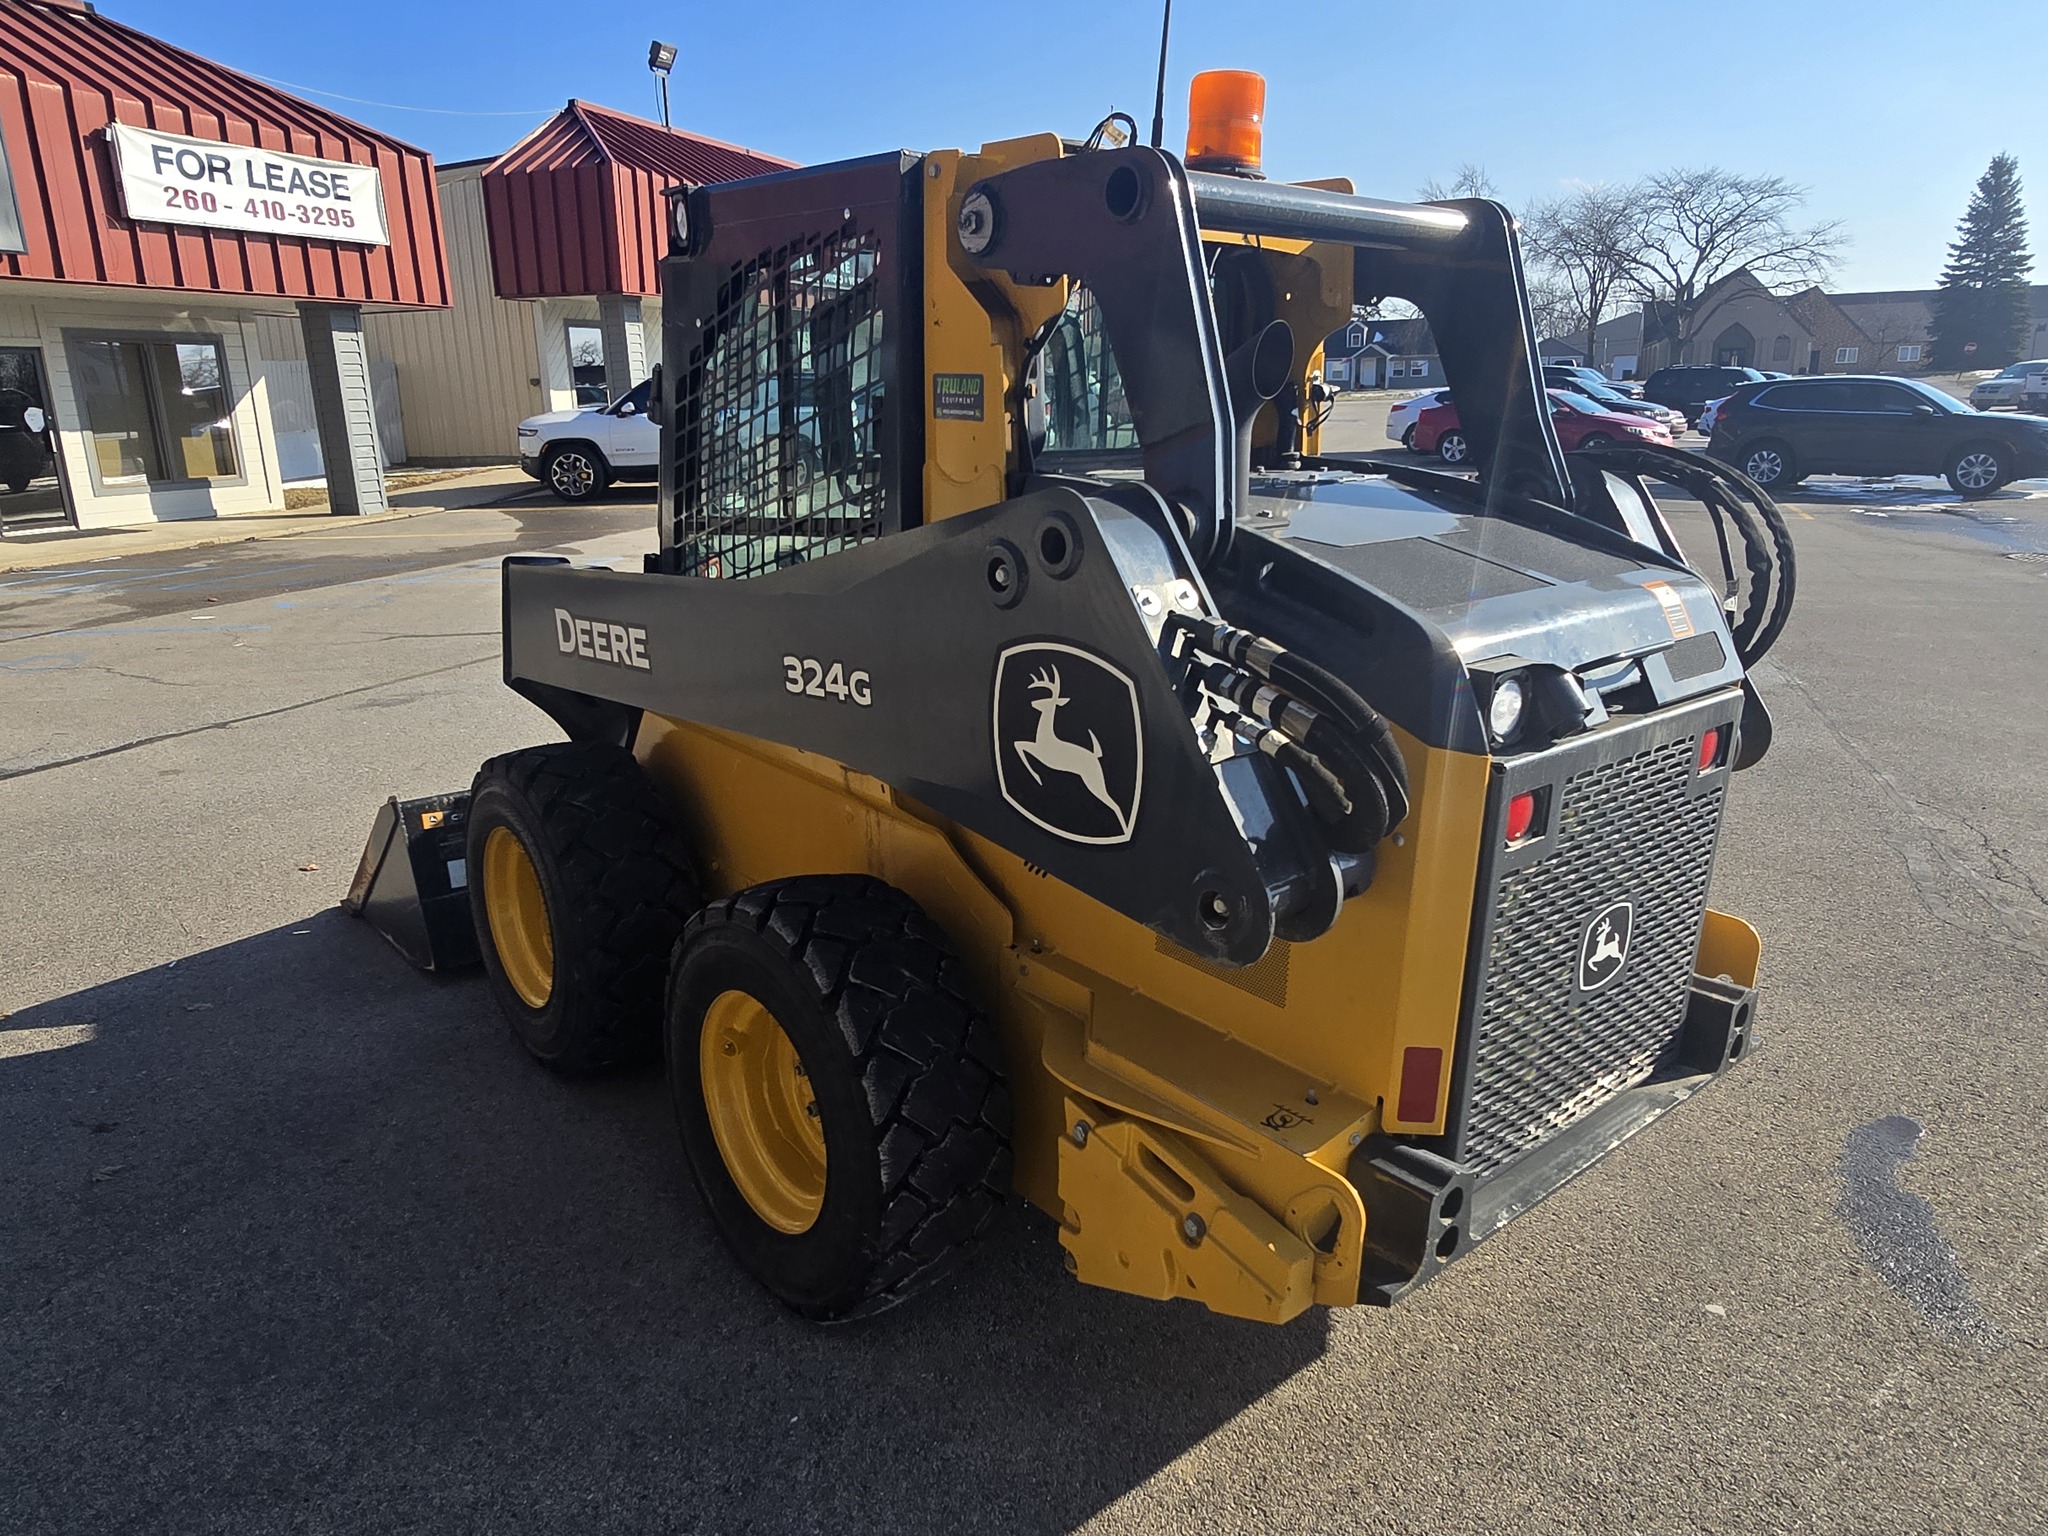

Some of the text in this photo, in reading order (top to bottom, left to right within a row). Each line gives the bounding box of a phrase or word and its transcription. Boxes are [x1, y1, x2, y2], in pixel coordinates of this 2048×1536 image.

[151, 144, 351, 202] FOR LEASE
[936, 377, 981, 395] TRULAND
[554, 608, 650, 669] DEERE
[783, 656, 872, 705] 324G
